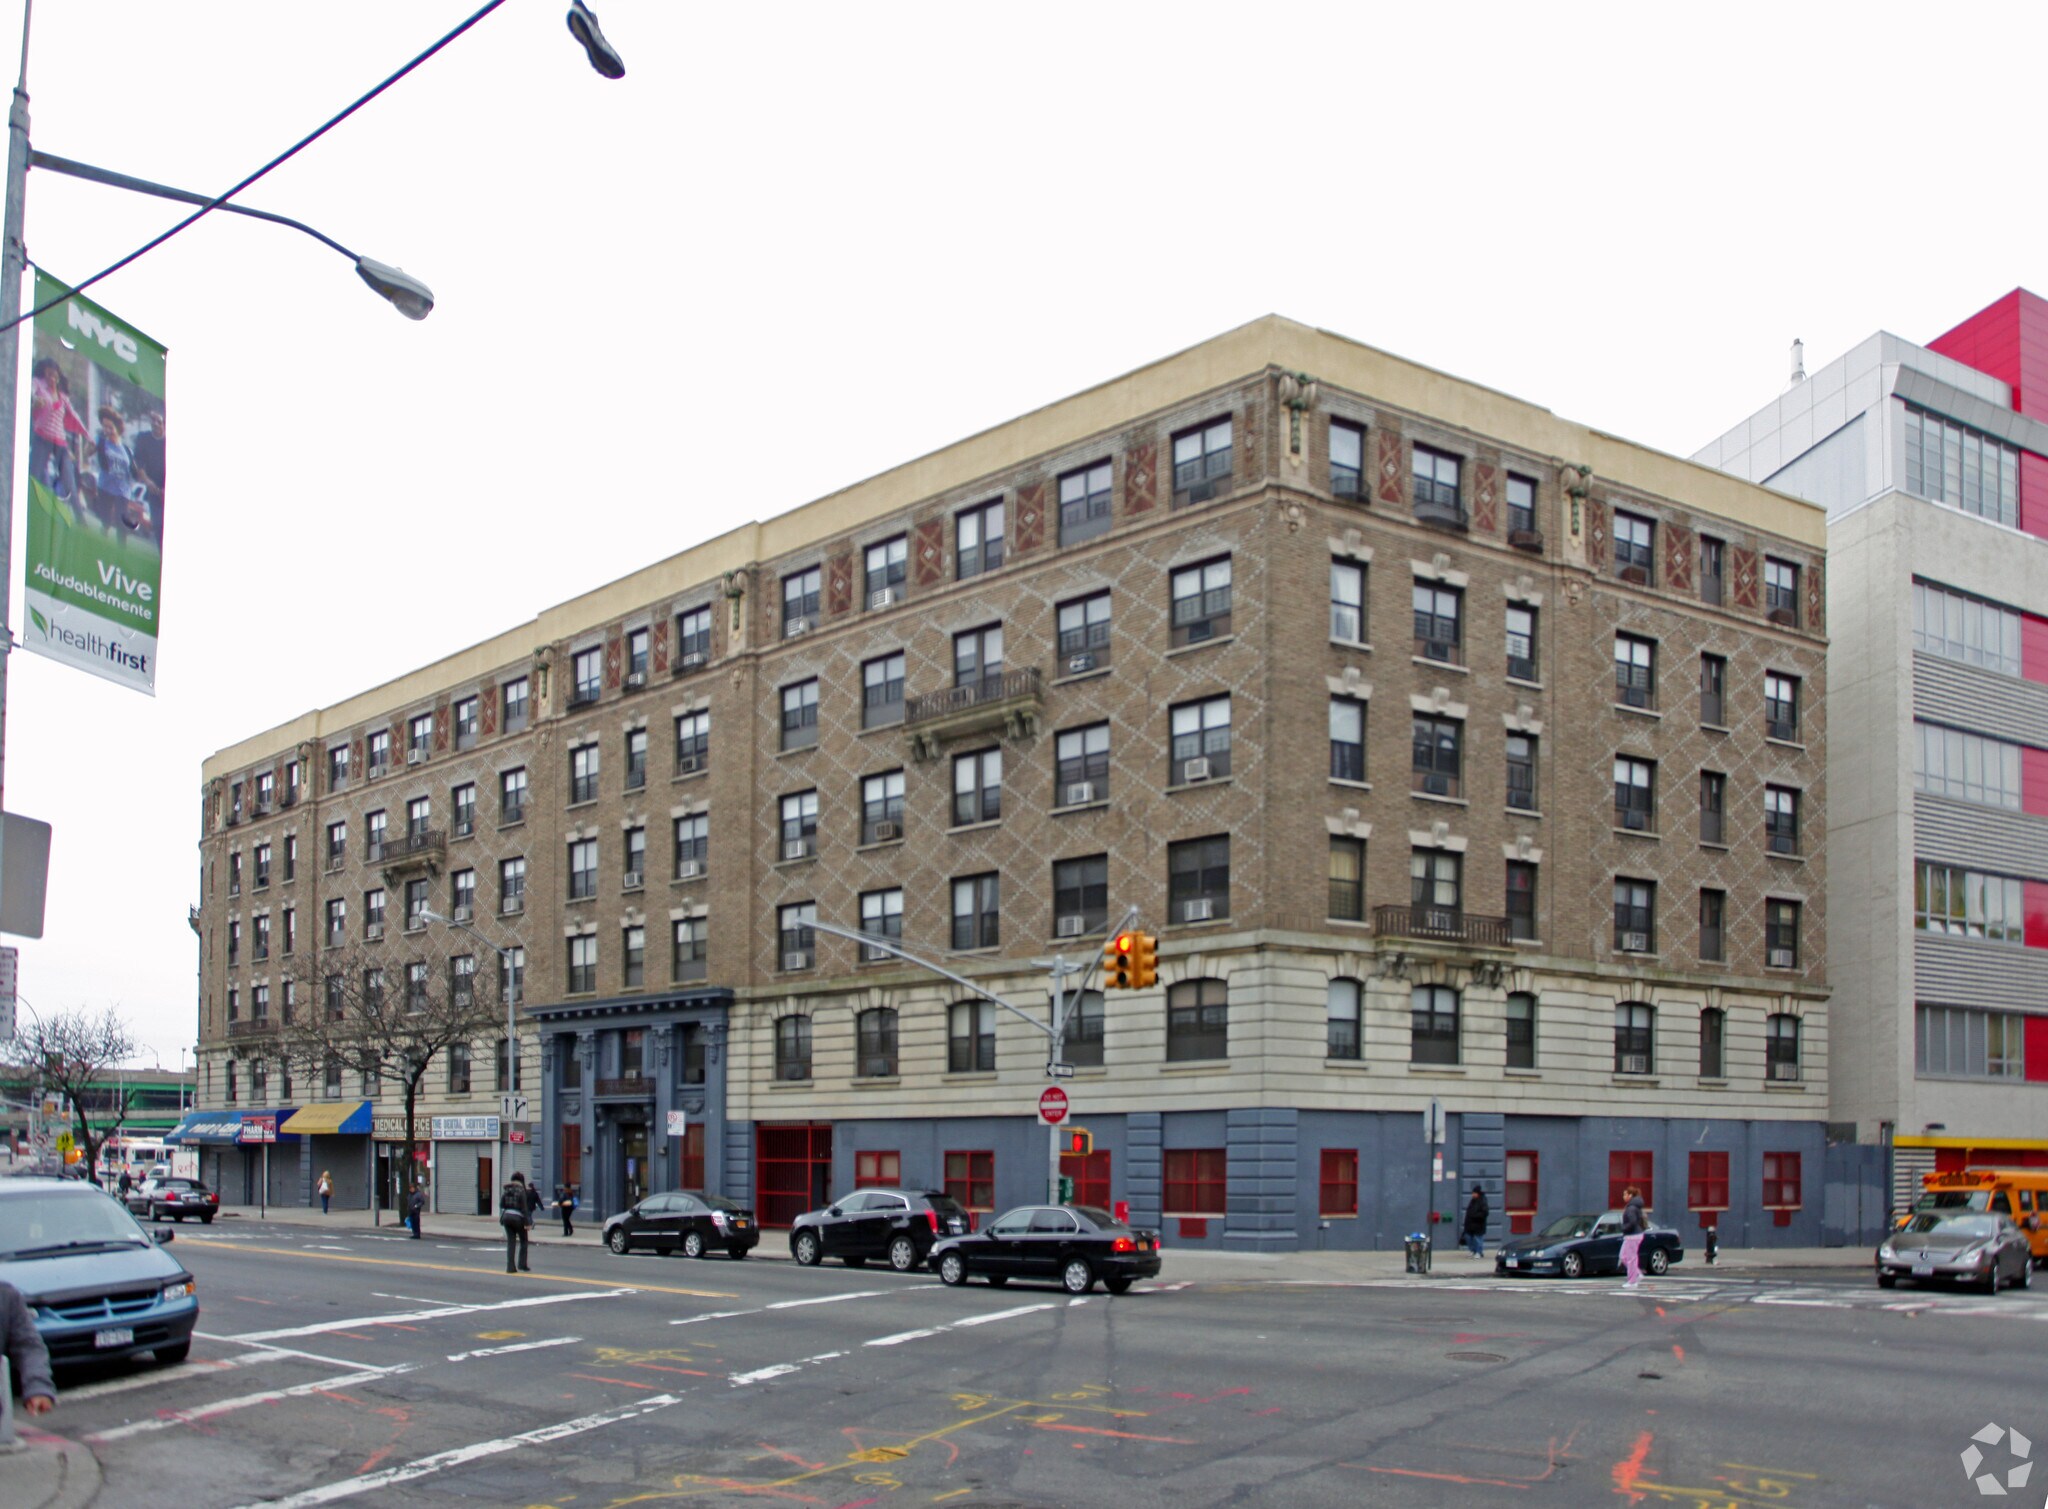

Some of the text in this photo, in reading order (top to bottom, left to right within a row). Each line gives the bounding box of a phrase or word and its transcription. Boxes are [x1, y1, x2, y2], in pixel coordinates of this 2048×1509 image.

[68, 301, 137, 364] NYC
[97, 559, 153, 601] Vive
[50, 618, 146, 673] healthfirst
[374, 1117, 430, 1131] MEDICAL FICE
[465, 1118, 486, 1129] CENTER
